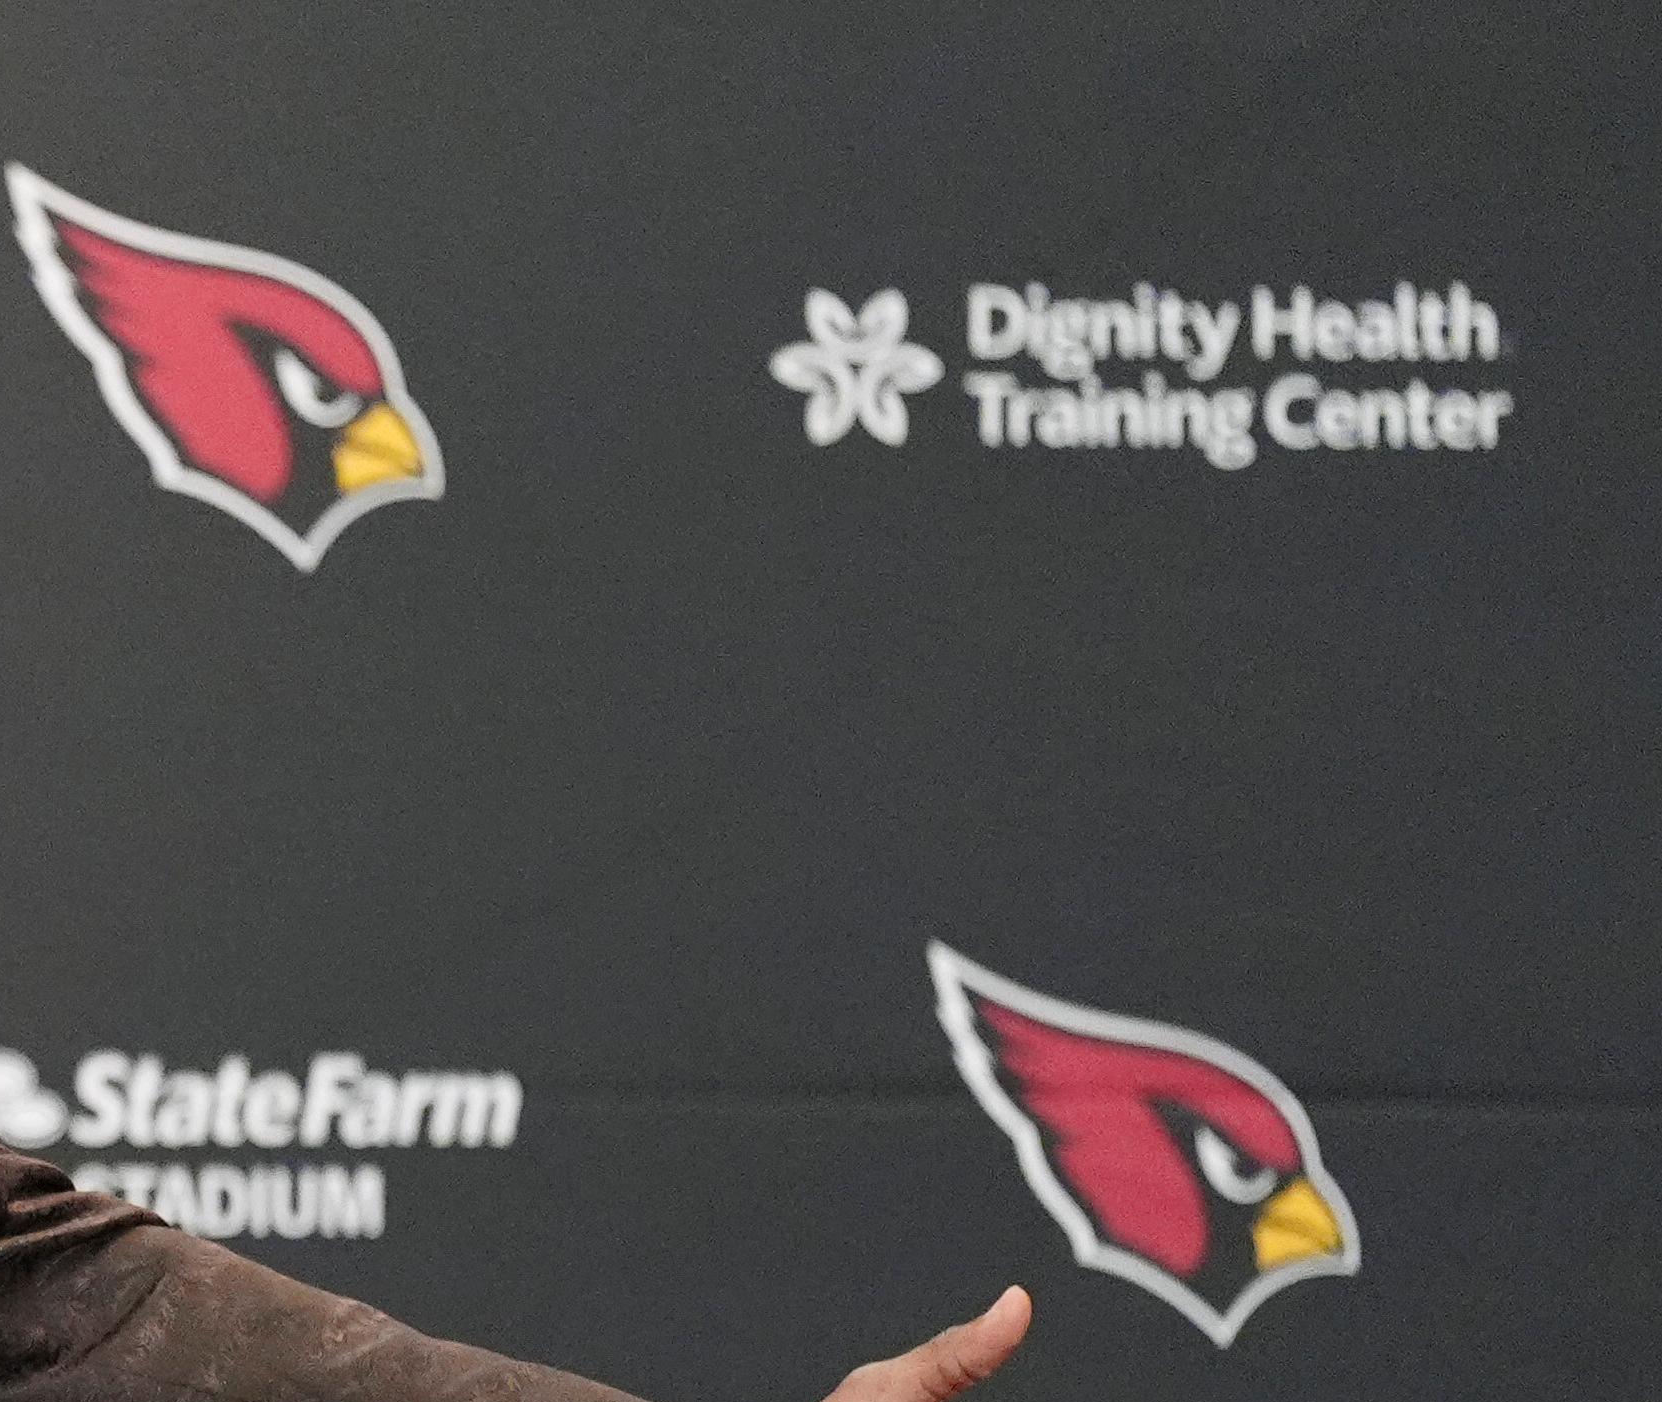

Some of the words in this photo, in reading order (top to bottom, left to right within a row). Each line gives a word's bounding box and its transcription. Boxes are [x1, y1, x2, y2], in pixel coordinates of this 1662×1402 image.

[964, 282, 1241, 381] Dignity
[1251, 281, 1500, 361] Health
[964, 371, 1257, 470] Training
[1263, 373, 1513, 450] Center
